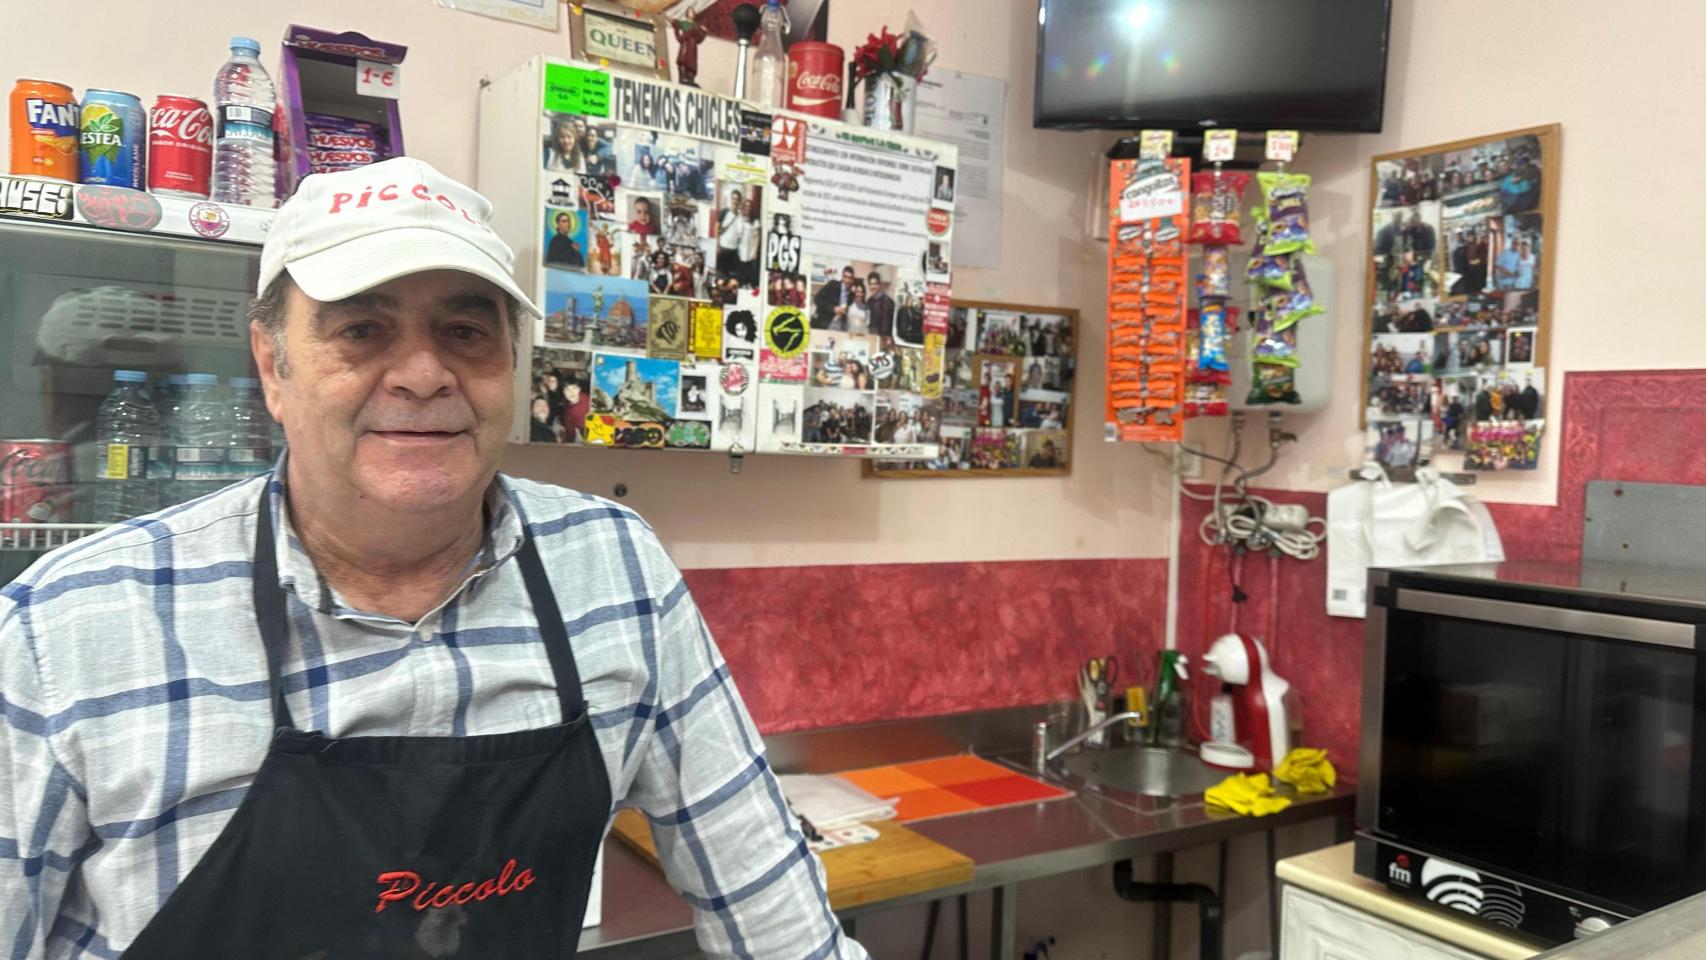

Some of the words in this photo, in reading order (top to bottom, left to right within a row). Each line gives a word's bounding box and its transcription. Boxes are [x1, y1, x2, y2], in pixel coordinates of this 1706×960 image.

[589, 28, 657, 57] QUEEN
[614, 77, 681, 132] TENEMOS
[685, 92, 741, 144] CHICLES
[768, 232, 800, 272] PGS
[374, 858, 537, 913] Piccolo
[1389, 861, 1412, 884] fm
